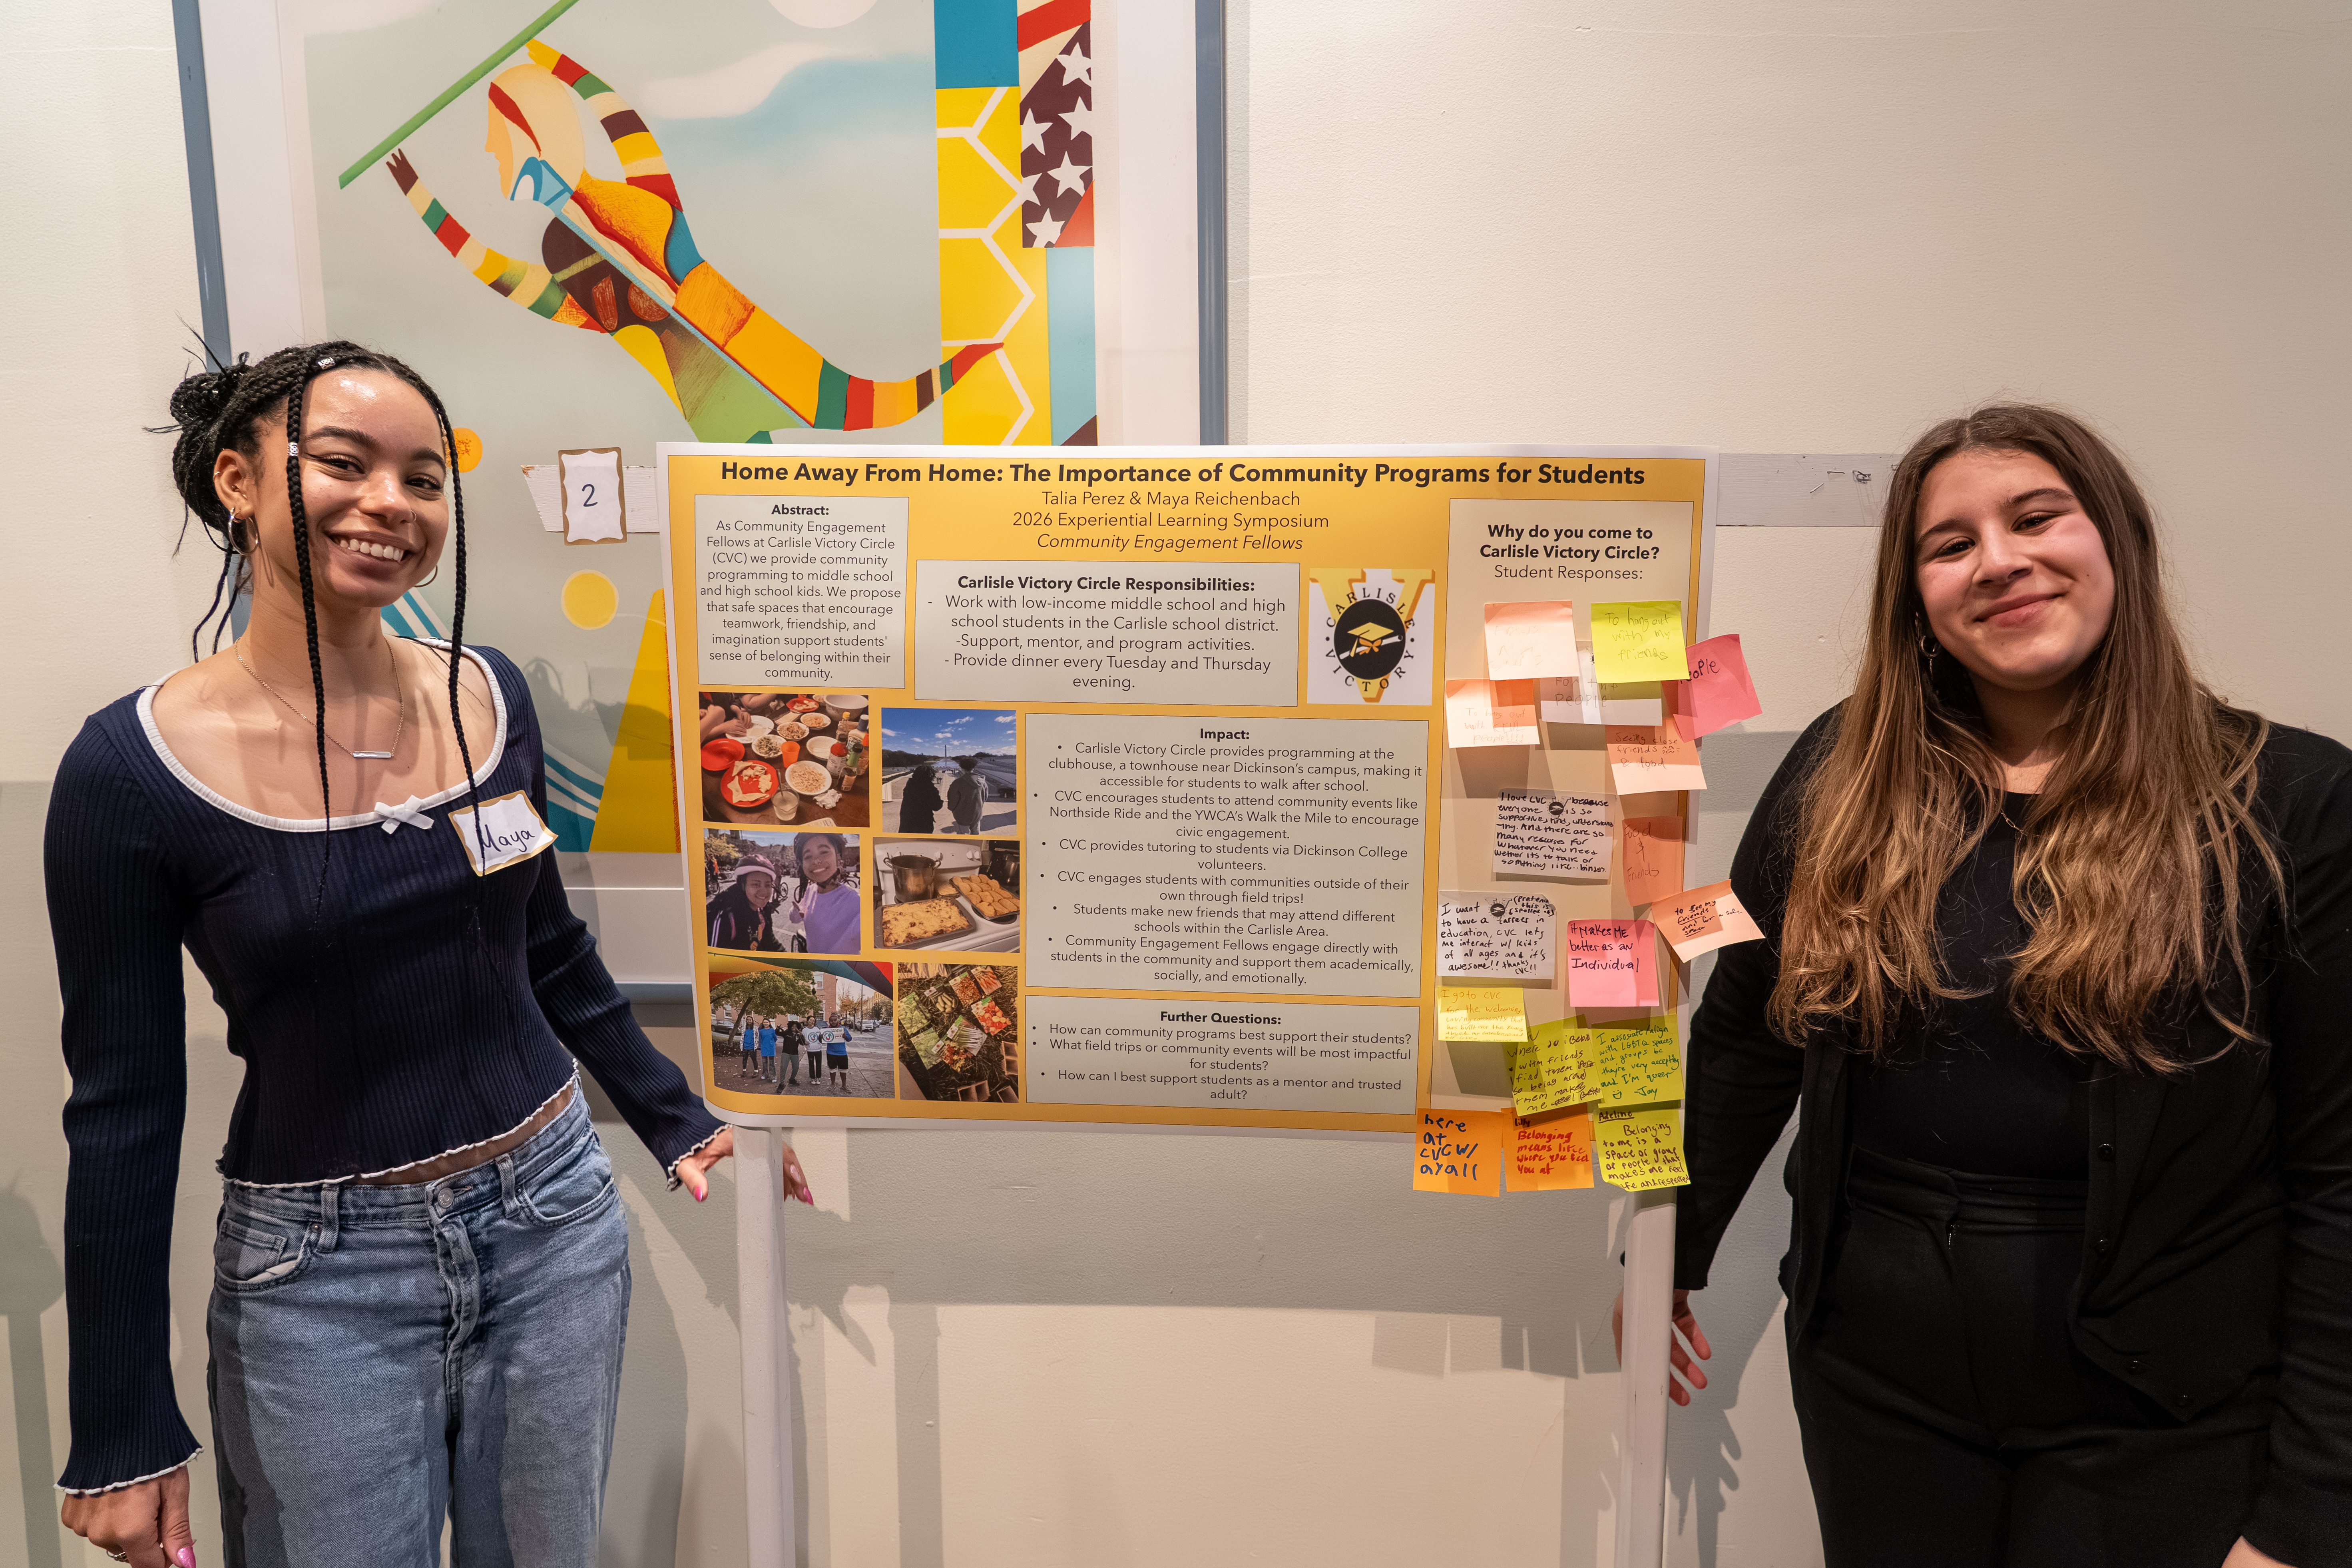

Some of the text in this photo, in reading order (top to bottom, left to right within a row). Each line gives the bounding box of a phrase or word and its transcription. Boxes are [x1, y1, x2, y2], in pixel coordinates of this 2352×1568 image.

[722, 462, 1645, 488] Home Away From Home: The Importance of Community Programs for Students
[581, 483, 598, 507] 2
[1042, 491, 1299, 509] Talia Perez & Maya Reichenbach
[771, 504, 829, 515] Abstract:
[716, 520, 886, 535] As Community Engagement
[1014, 512, 1328, 531] 2026 Experiential Learning Symposium
[1488, 524, 1652, 542] Why do you come to
[707, 536, 750, 547] Fellows
[768, 537, 811, 548] Carlisle
[815, 538, 856, 551] Victory
[860, 538, 894, 548] Circle
[1038, 534, 1302, 552] Community Engagement Fellows
[713, 552, 747, 564] (CVC)
[771, 553, 816, 566] provide
[821, 555, 887, 568] community
[1480, 544, 1659, 562] Carlisle Victory Circle?
[708, 570, 892, 583] programming to middle school
[1495, 565, 1642, 582] Student Responses:
[958, 576, 1254, 594] Carlisle Victory Circle Responsibilities:
[946, 595, 1285, 615] Work with low-income middle school and high
[1326, 588, 1415, 629] CARLISLE
[1605, 613, 1619, 626] To
[1627, 607, 1649, 632] hang
[1612, 630, 1643, 642] with
[1618, 648, 1668, 661] friends
[955, 653, 1271, 674] Provide dinner every Tuesday and Thursday
[1325, 649, 1414, 692] VICTORY
[1073, 675, 1134, 691] evening.
[1201, 728, 1249, 742] Impact:
[1076, 743, 1394, 761] Carlisle Victory Circle provides programming at the
[481, 824, 535, 853] Maya
[1060, 839, 1407, 860] CVC provides tutoring to students via Dickinson College
[1074, 904, 1126, 915] Students
[1132, 905, 1163, 916] make
[1196, 907, 1238, 918] friends
[1242, 908, 1266, 918] that
[1270, 912, 1295, 922] may
[1299, 910, 1338, 920] attend
[1343, 911, 1395, 922] different
[1441, 902, 1480, 916] I want
[1440, 927, 1492, 938] education,
[1526, 927, 1544, 939] lets
[1570, 922, 1577, 934] it
[1460, 939, 1494, 947] interact
[1501, 939, 1512, 949] w/
[1569, 939, 1599, 951] better
[1445, 950, 1454, 959] of
[1479, 950, 1499, 960] ages
[1530, 949, 1546, 960] it's
[1571, 958, 1639, 972] Individual
[1161, 1011, 1281, 1024] Further Questions:
[1050, 1024, 1076, 1034] How
[1105, 1027, 1173, 1040] community
[1177, 1031, 1235, 1041] programs
[1240, 1029, 1265, 1040] best
[1269, 1033, 1317, 1044] support
[1320, 1031, 1348, 1042] their
[1352, 1033, 1411, 1044] students?
[1599, 1038, 1673, 1056] with LGBTQ spaces
[1601, 1055, 1616, 1064] and
[1620, 1050, 1648, 1064] groups
[1601, 1071, 1675, 1087] and I'm queer
[1425, 1114, 1466, 1132] here
[1623, 1124, 1671, 1137] Belonging
[1423, 1132, 1447, 1146] at
